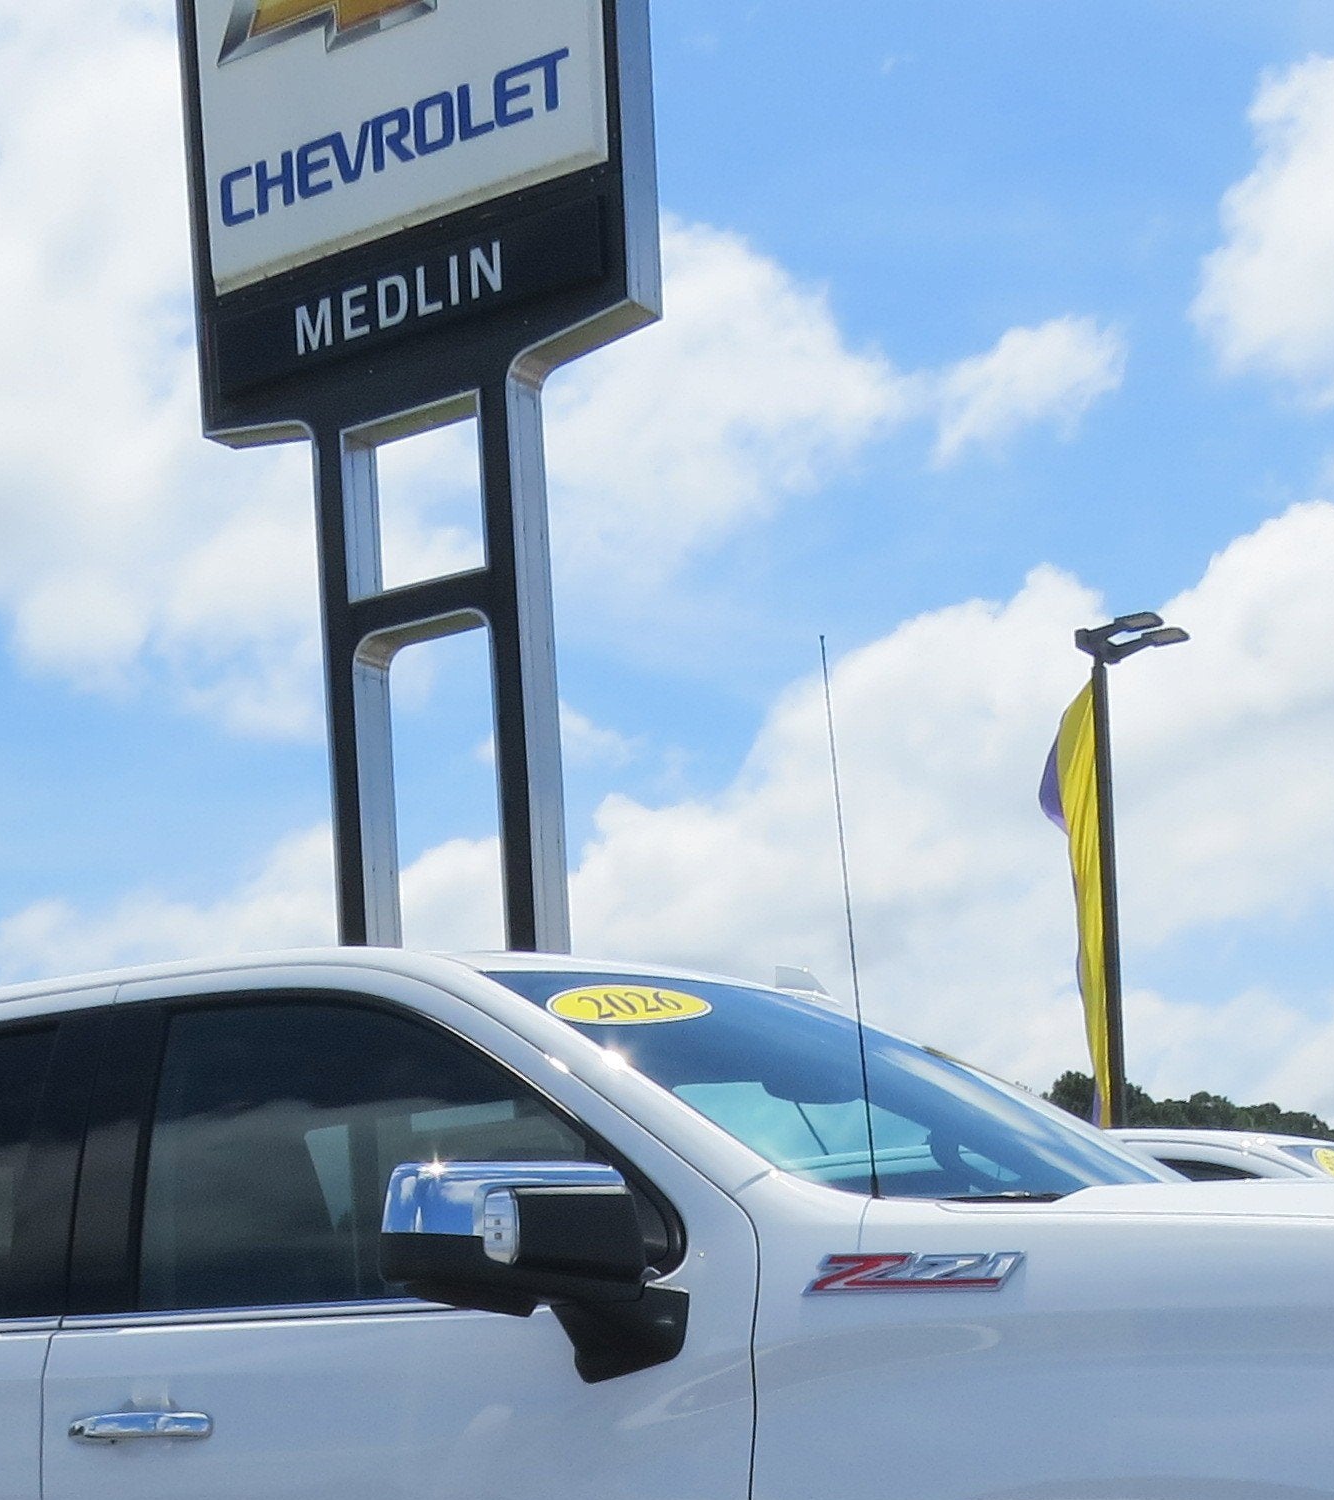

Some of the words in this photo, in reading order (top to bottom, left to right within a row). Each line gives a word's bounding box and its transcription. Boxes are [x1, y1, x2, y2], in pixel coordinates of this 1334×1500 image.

[219, 47, 569, 227] CHEVROLET
[295, 241, 504, 355] MEDLIN
[578, 991, 683, 1019] 2026
[801, 1250, 1025, 1296] Z71
